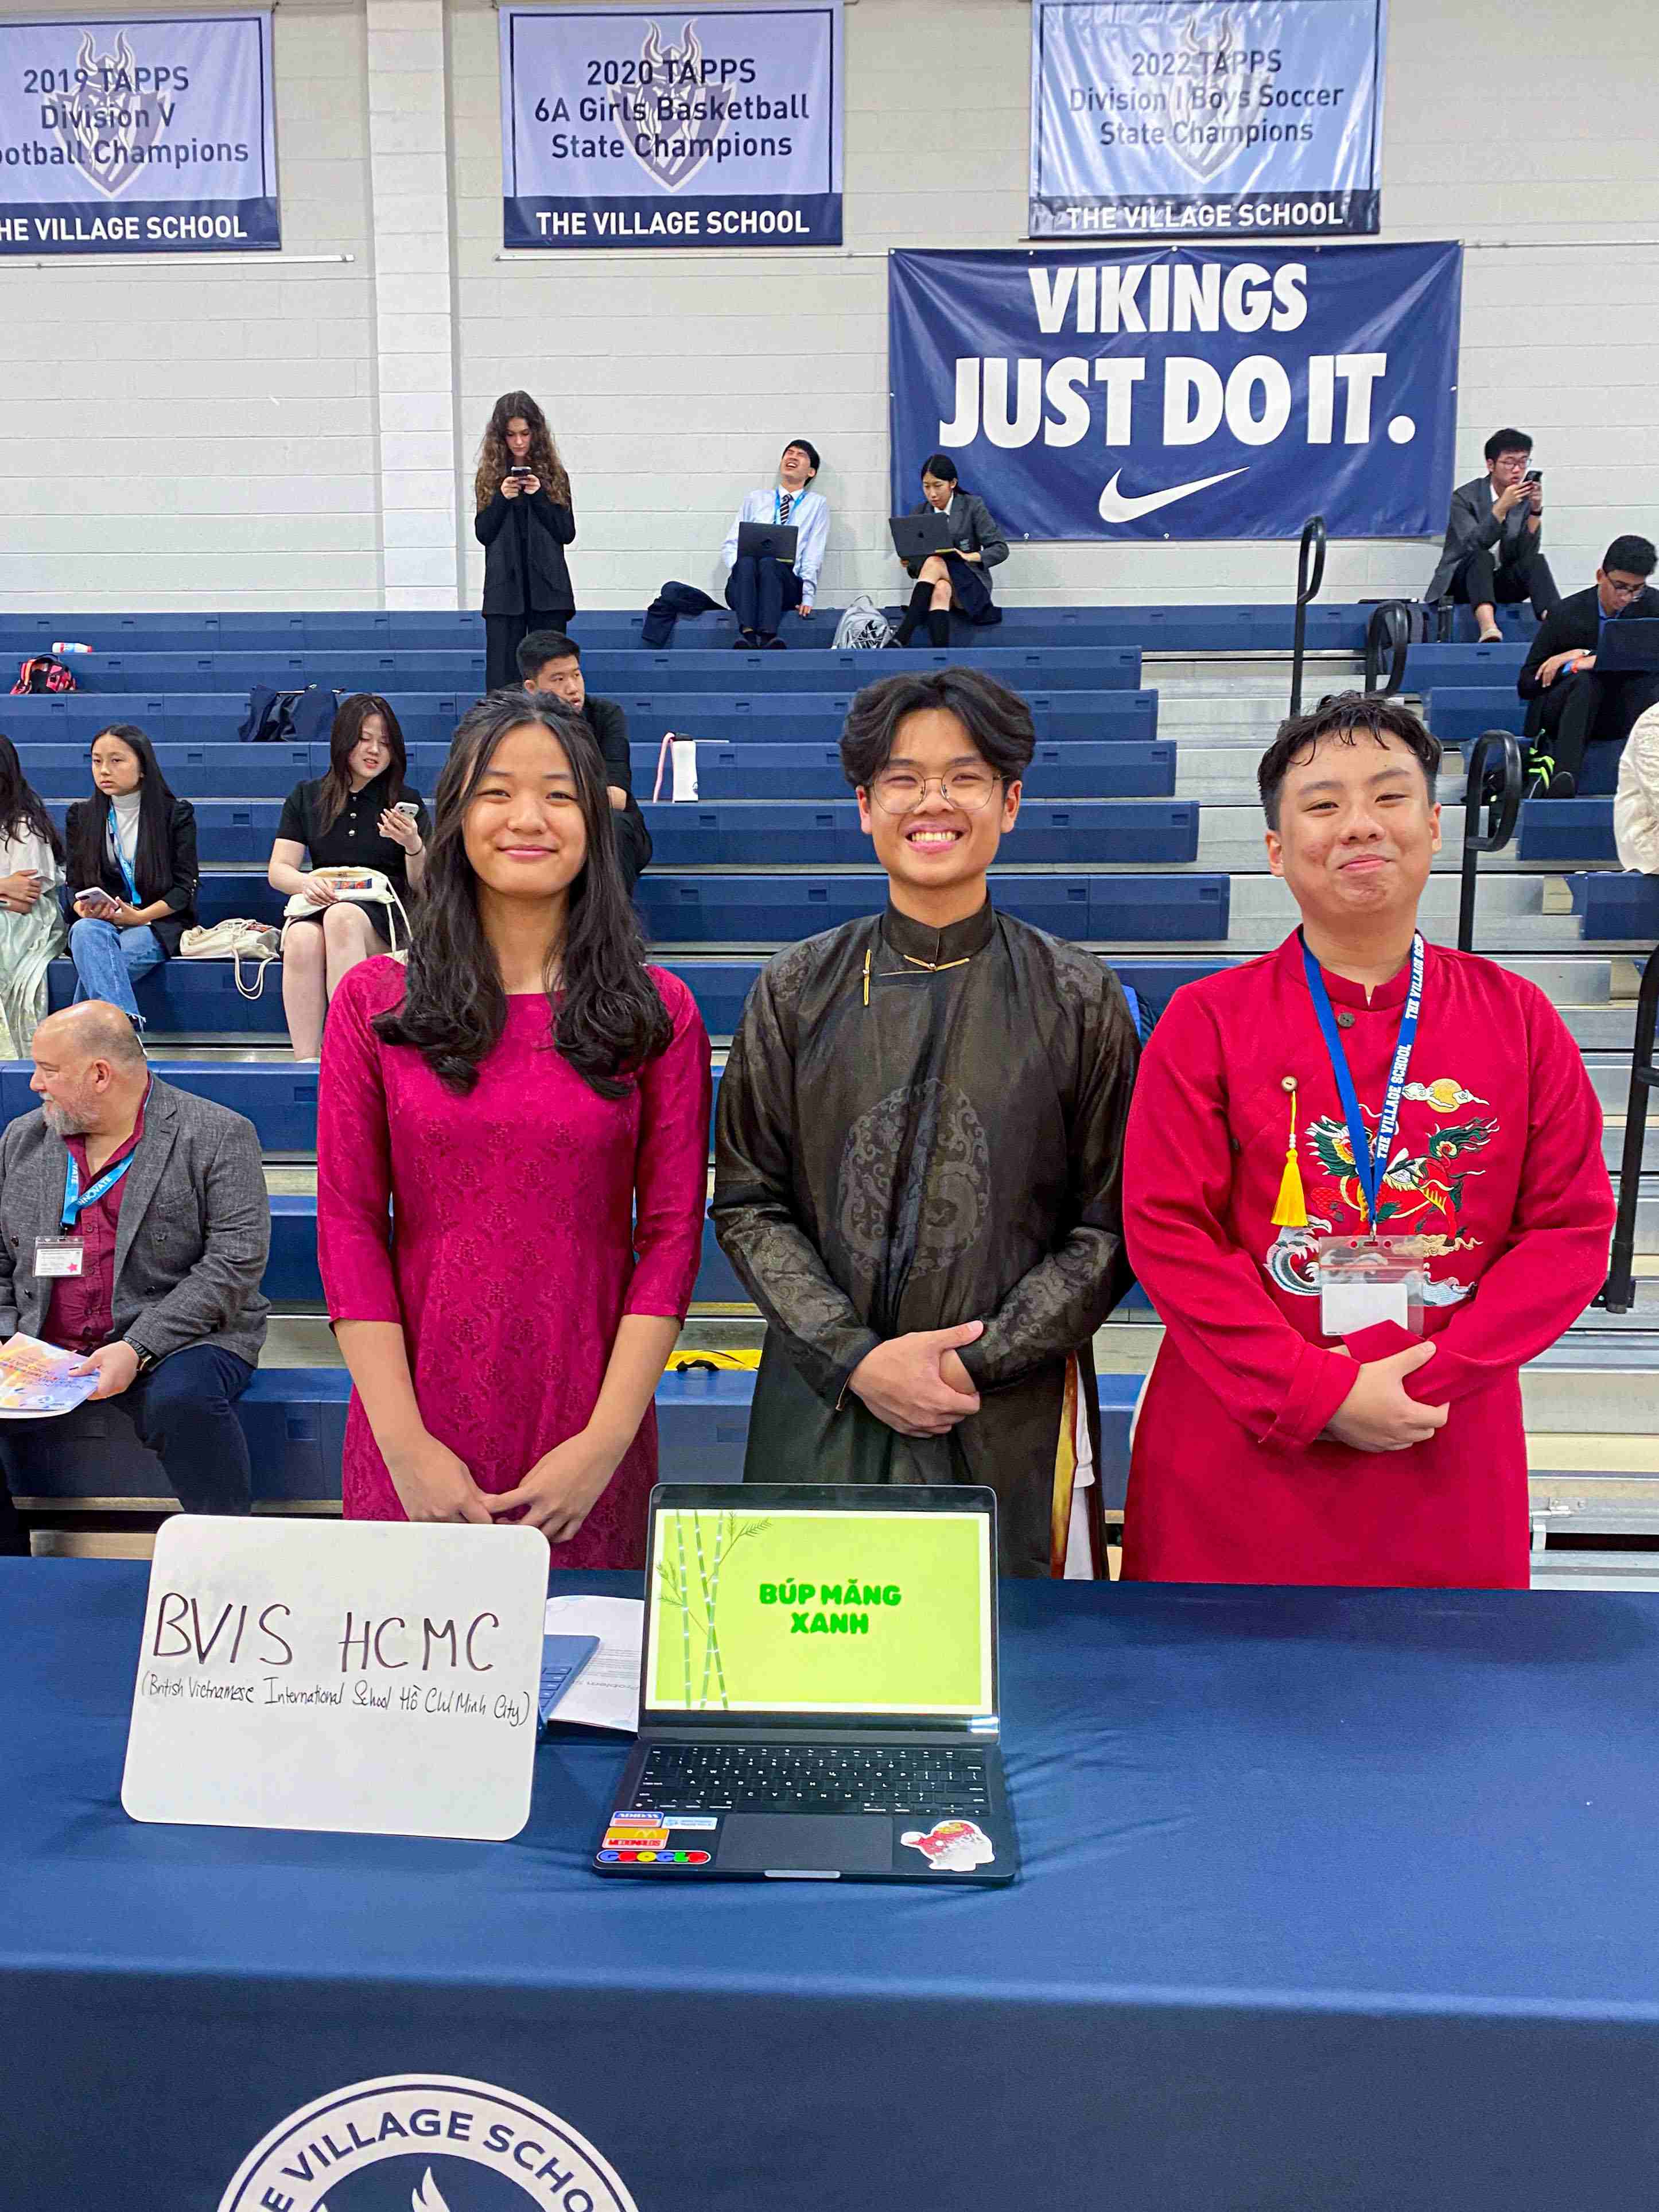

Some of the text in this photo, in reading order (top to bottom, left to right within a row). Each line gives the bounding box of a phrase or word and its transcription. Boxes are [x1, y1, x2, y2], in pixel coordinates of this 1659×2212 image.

[588, 59, 756, 86] 2020 TAPPS
[1132, 49, 1282, 76] 2022 TAPPS
[24, 67, 189, 94] 2019 TAPPS
[535, 94, 809, 122] 6A Girls Basketball
[1071, 87, 1167, 112] Division
[1192, 86, 1250, 119] Boys
[1258, 84, 1344, 108] Soccer
[41, 102, 176, 130] Division V
[1100, 119, 1314, 148] State Champions
[0, 138, 248, 169] otball Champions
[551, 133, 792, 163] State Champions
[34, 216, 141, 241] VILLAGE
[146, 215, 247, 239] SCHOOL
[537, 209, 810, 235] THE VILLAGE SCHOOL
[1067, 202, 1343, 230] THE VILLAGE SCHOOL
[1028, 262, 1308, 334] VIKINGS
[939, 352, 1416, 449] JUST DO IT.
[1409, 957, 1424, 998] VILLAGE
[1405, 998, 1420, 1020] THE
[1377, 1044, 1412, 1159] THE VILLAGE SCHOOL
[759, 1578, 902, 1606] BÚP MĂNG
[153, 1592, 499, 1672] BVIS HCMC
[790, 1612, 869, 1635] XANH
[262, 1677, 345, 1705] International
[352, 1679, 393, 1710] School
[280, 2108, 474, 2183] VILLAGE
